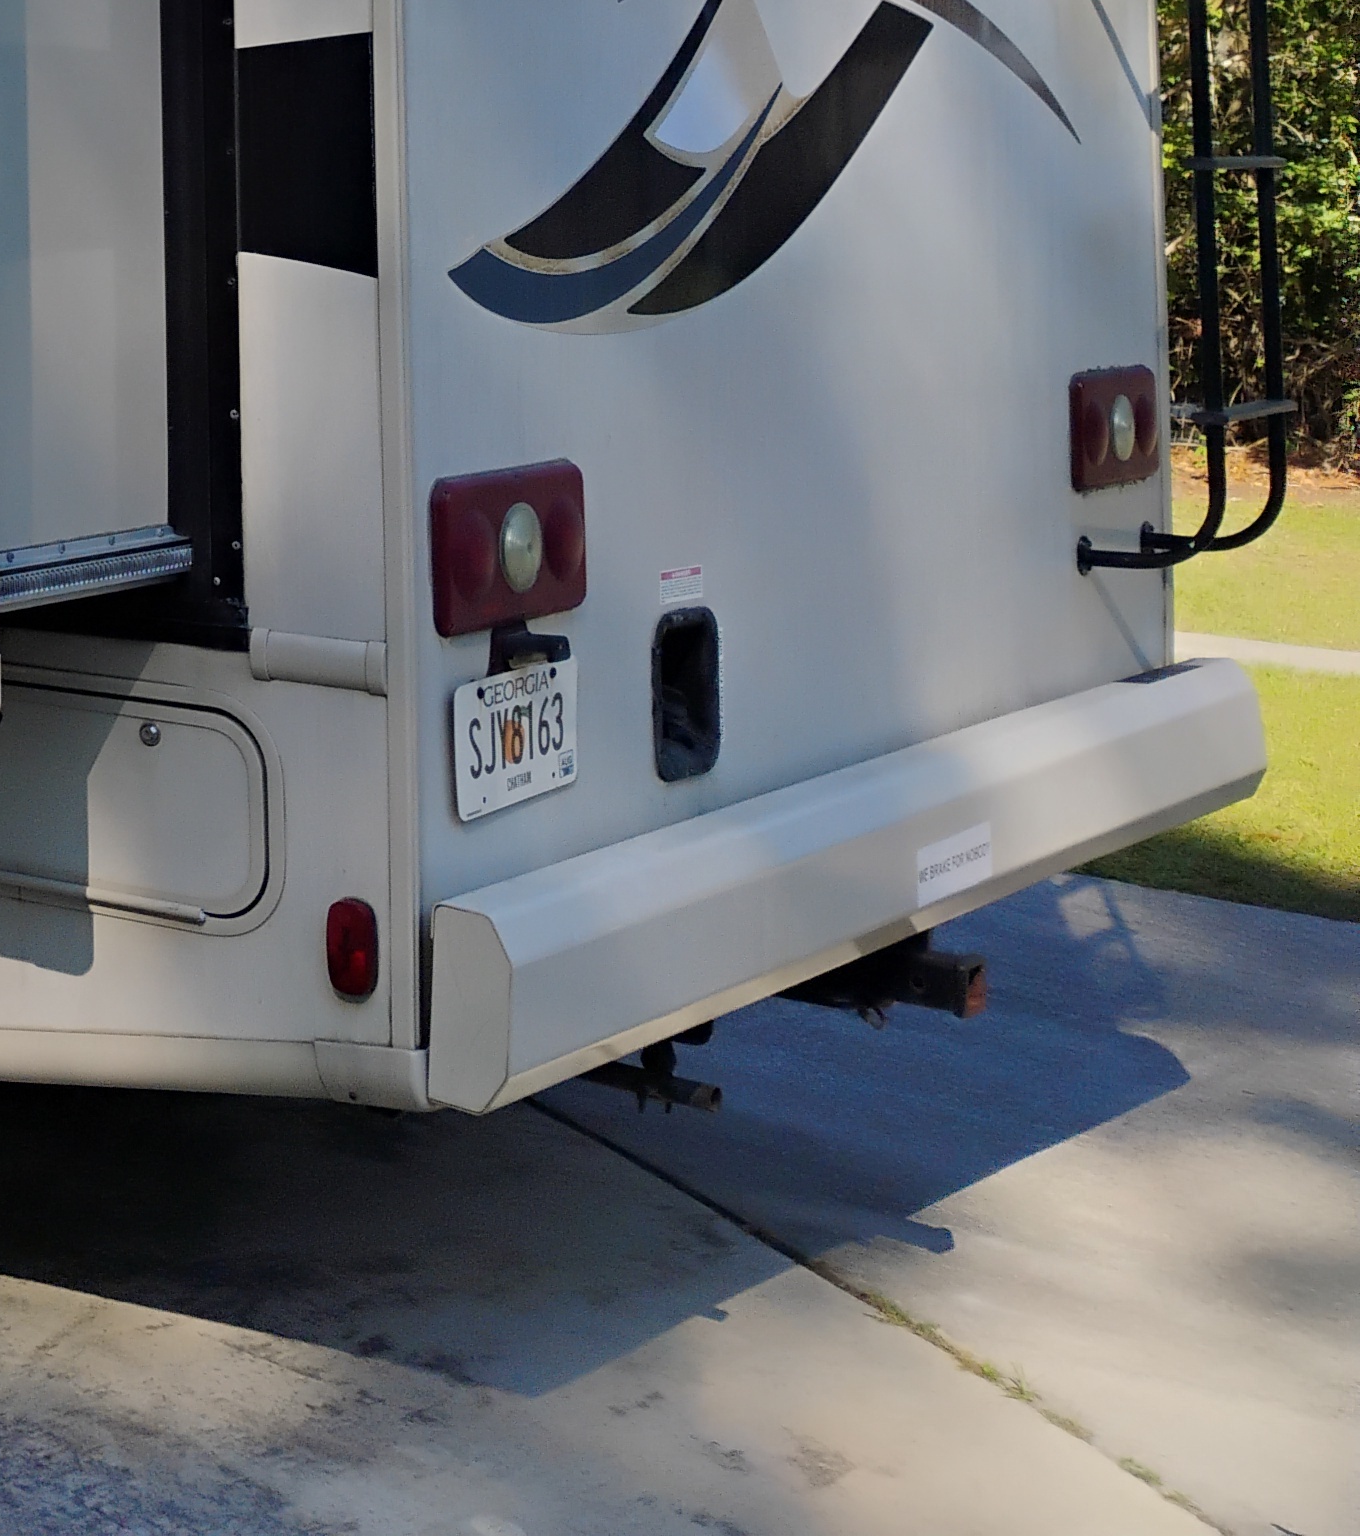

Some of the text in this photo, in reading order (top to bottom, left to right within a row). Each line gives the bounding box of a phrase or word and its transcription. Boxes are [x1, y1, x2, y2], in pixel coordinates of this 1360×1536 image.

[483, 671, 549, 707] GEORGIA
[469, 692, 564, 780] SJY8163
[919, 867, 928, 883] WE
[952, 852, 964, 869] FOR
